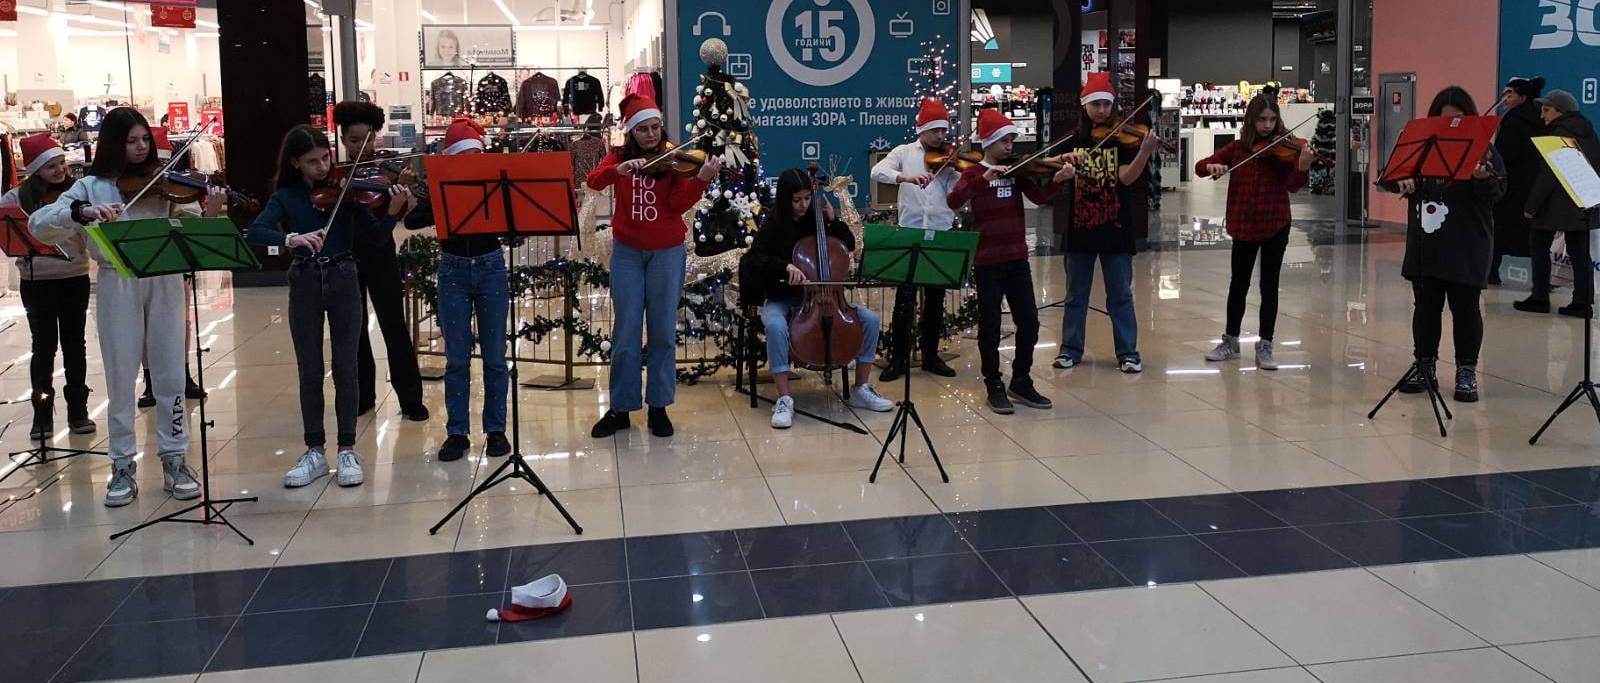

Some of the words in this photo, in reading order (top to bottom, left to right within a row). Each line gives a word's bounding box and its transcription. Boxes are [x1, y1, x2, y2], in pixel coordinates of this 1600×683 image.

[795, 10, 846, 62] 15
[760, 97, 861, 112] удоволствието
[865, 98, 872, 108] в
[752, 115, 808, 126] магазин
[812, 112, 847, 126] ЗОРА
[860, 112, 908, 125] Плевен
[632, 173, 656, 190] HO
[632, 188, 657, 205] HO
[631, 205, 658, 222] HO
